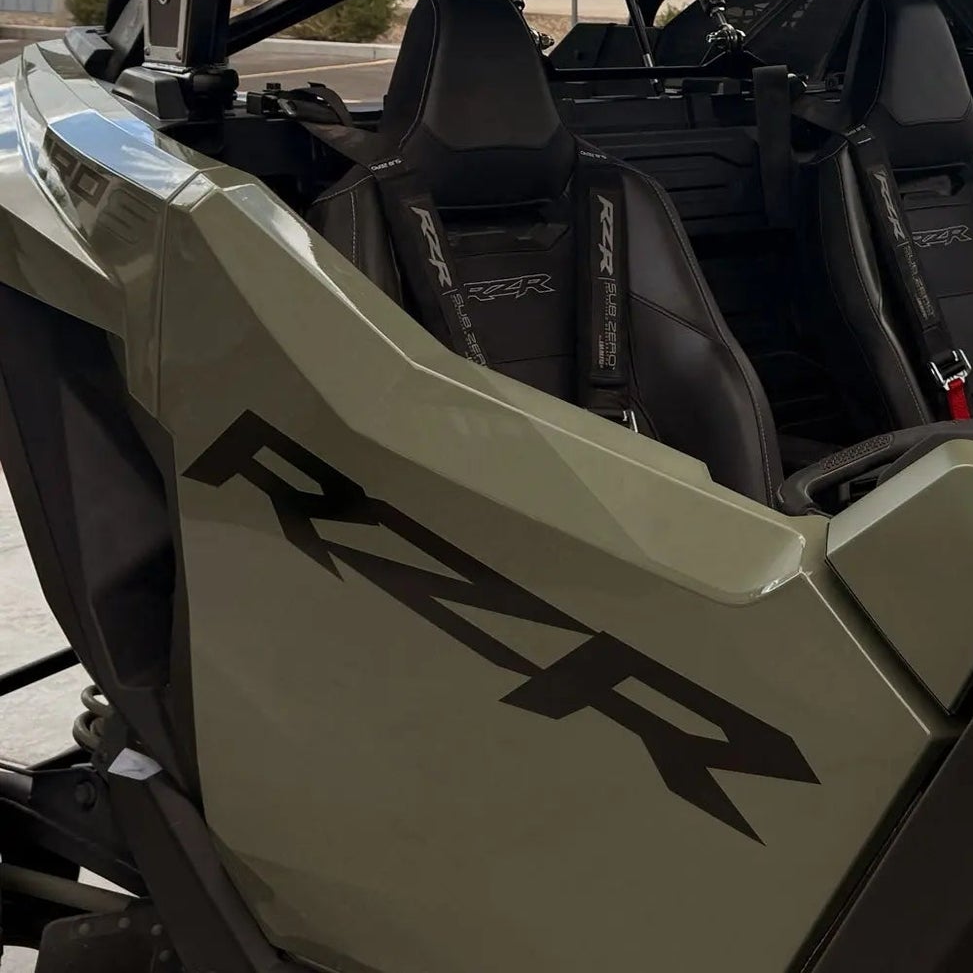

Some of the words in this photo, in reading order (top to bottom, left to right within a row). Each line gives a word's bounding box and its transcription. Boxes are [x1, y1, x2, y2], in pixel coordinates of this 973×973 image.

[597, 194, 614, 276] RZR
[410, 206, 452, 288] RZR
[453, 293, 472, 328] SUB
[467, 332, 487, 365] ZER
[463, 273, 556, 302] RZR
[608, 283, 617, 317] SUB
[608, 320, 617, 367] ZERO
[182, 409, 822, 847] RZR
